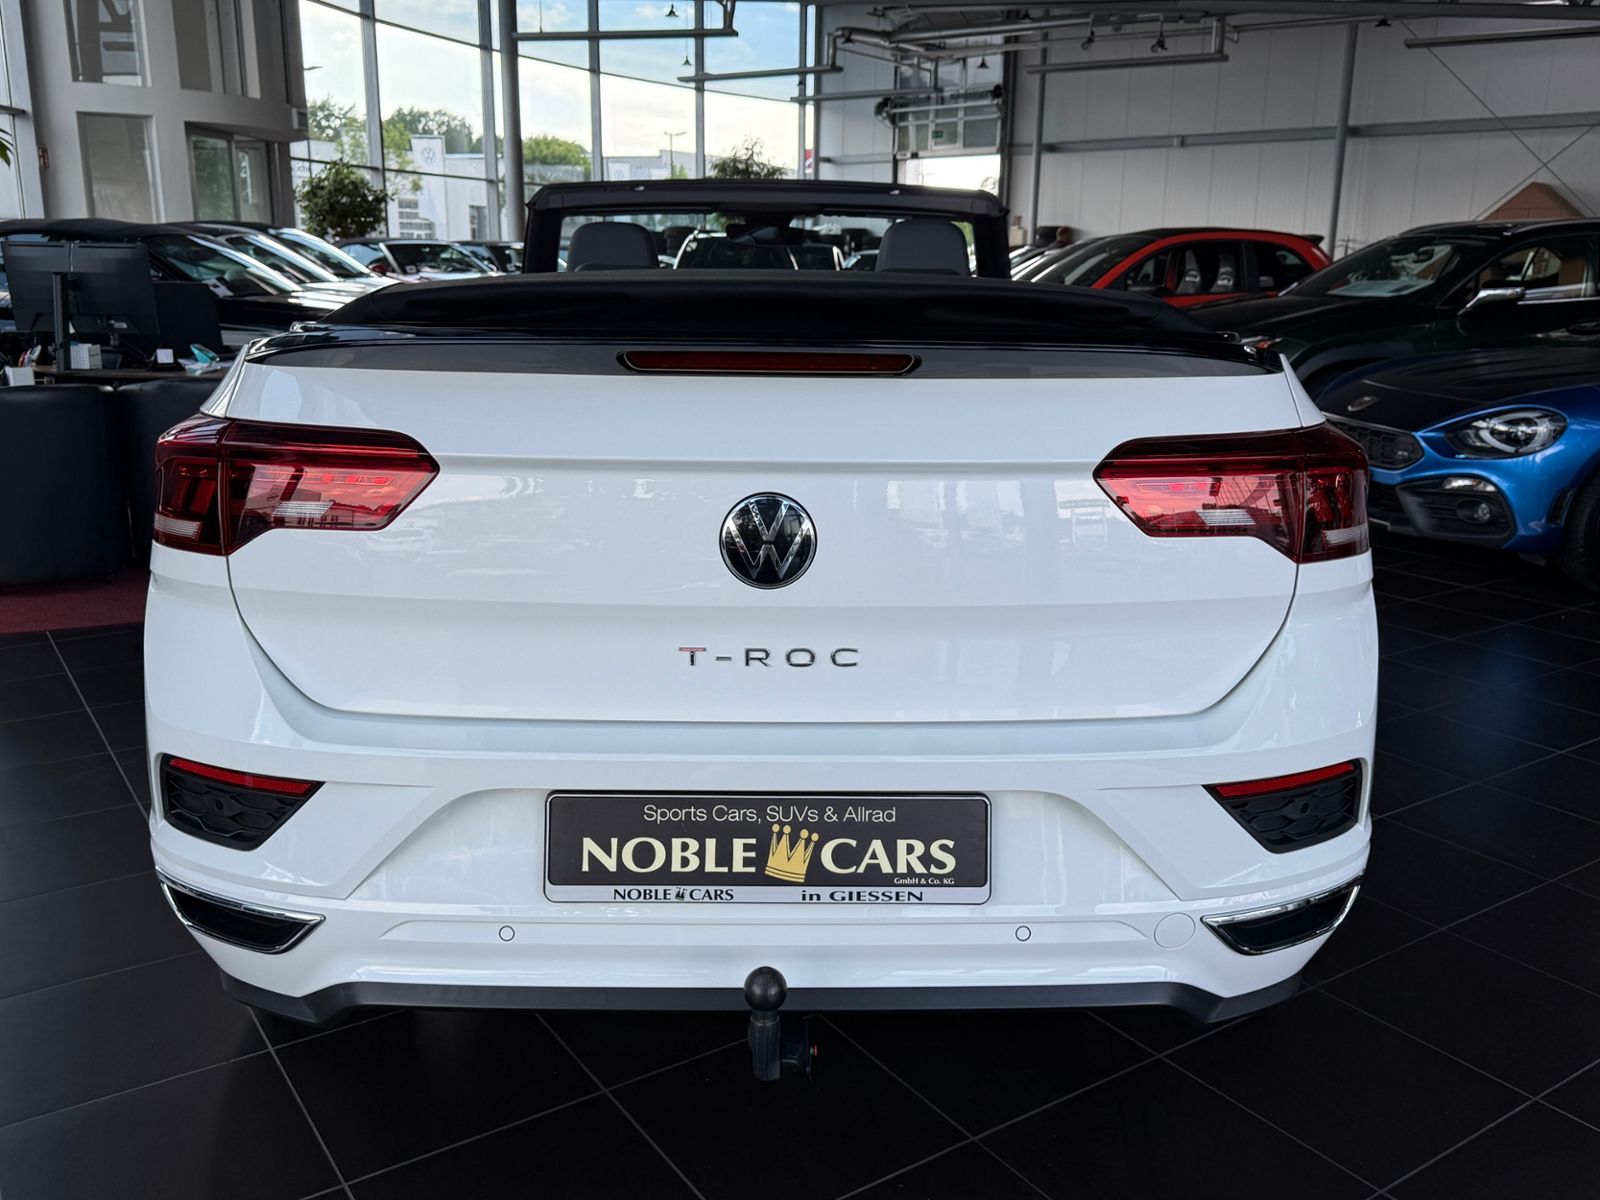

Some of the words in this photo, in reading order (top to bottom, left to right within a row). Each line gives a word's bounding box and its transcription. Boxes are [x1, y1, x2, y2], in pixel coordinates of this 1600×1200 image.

[678, 646, 860, 668] T-ROC
[643, 804, 708, 824] Sports
[712, 805, 762, 824] Cars,
[766, 805, 819, 823] SUVs
[823, 806, 838, 823] &
[843, 806, 896, 823] Allrad
[581, 836, 758, 873] NOBLE
[820, 838, 957, 875] CARS
[893, 877, 918, 885] GmbH
[920, 877, 927, 885] &
[928, 877, 942, 885] Co.
[943, 877, 955, 885] KG
[613, 888, 672, 901] NOBLE
[689, 889, 734, 901] CARS
[801, 890, 821, 901] in
[829, 891, 923, 902] GIESSEN
